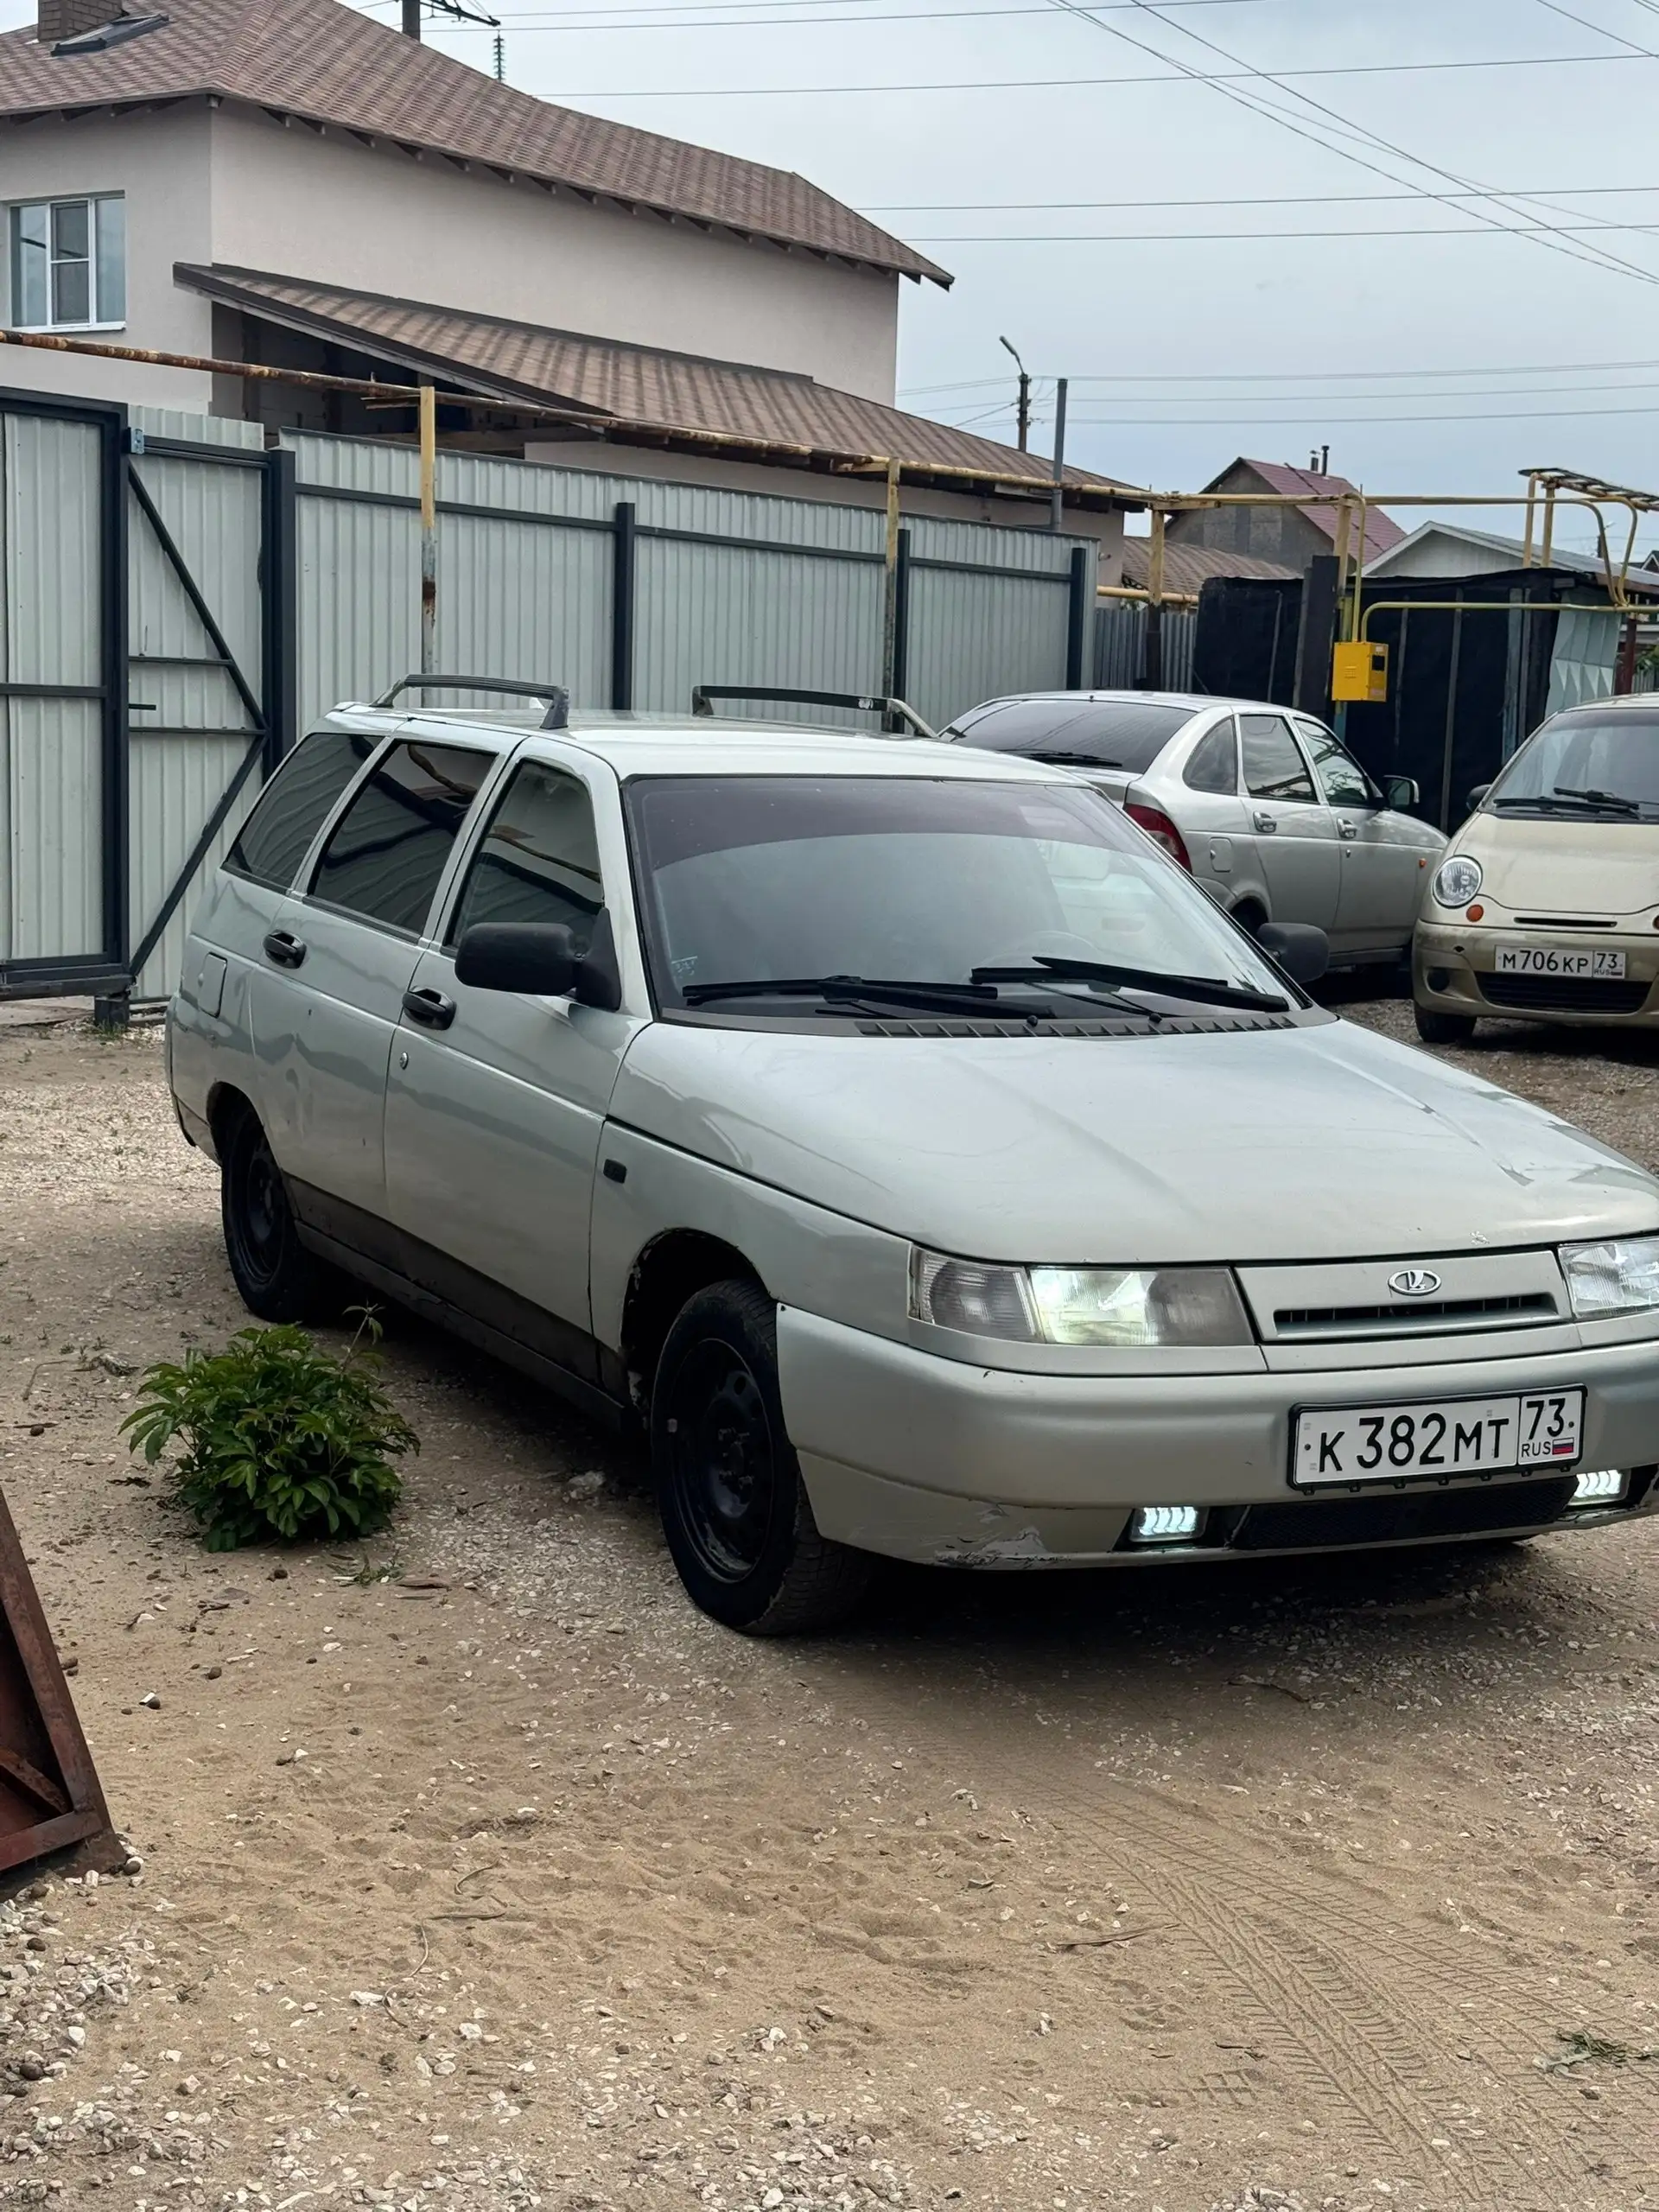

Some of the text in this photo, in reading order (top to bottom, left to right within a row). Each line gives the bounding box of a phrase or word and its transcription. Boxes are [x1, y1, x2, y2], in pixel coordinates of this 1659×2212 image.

[1596, 952, 1618, 969] 73
[1319, 1397, 1566, 1472] К382МТ 73
[1521, 1440, 1552, 1459] RUS
